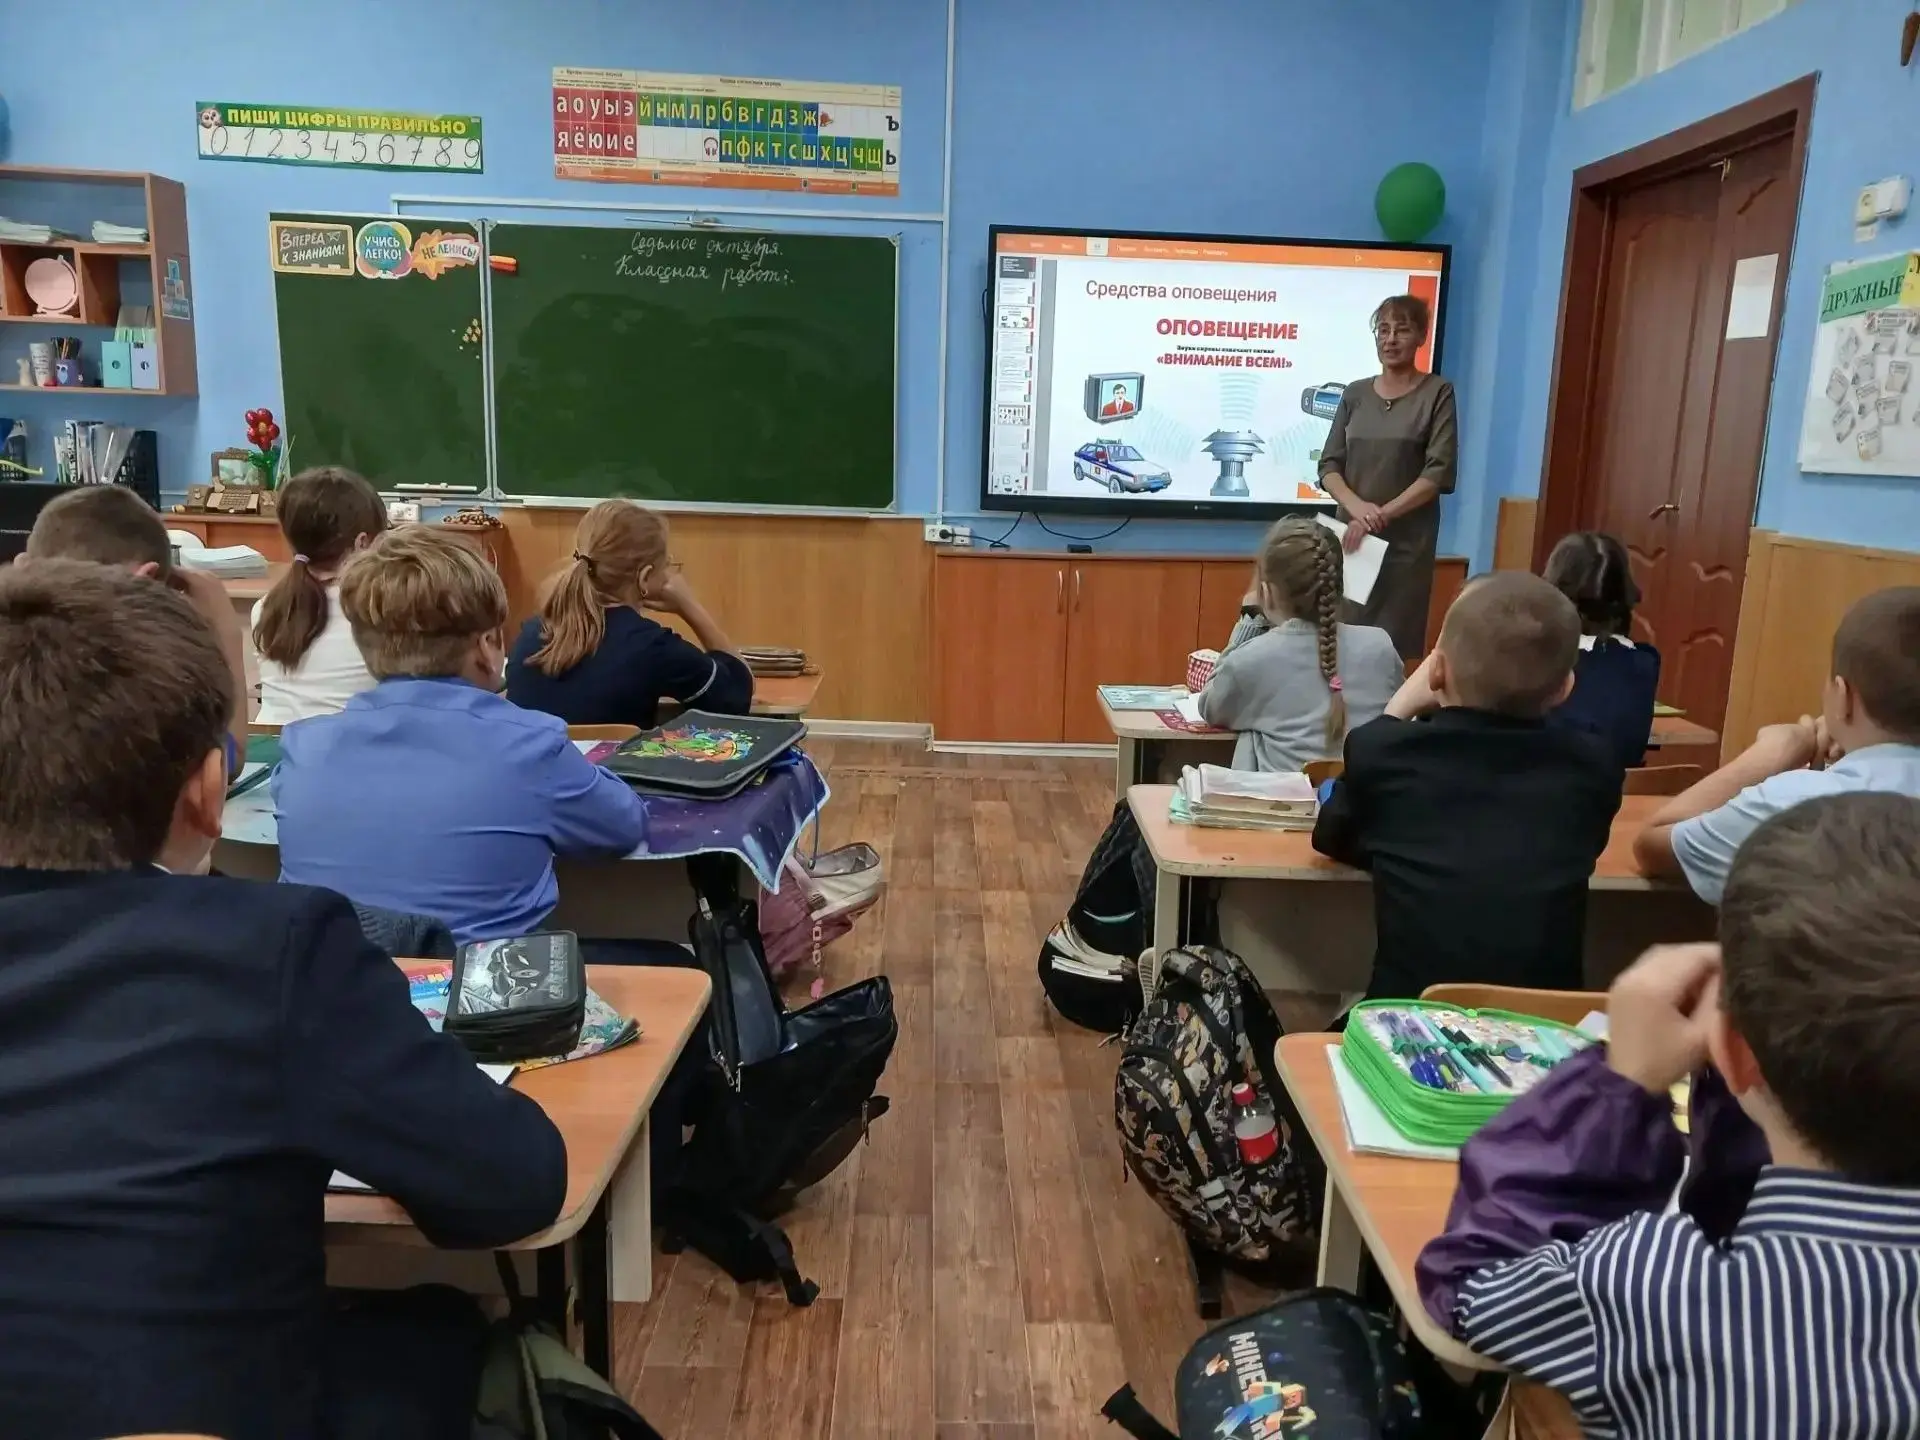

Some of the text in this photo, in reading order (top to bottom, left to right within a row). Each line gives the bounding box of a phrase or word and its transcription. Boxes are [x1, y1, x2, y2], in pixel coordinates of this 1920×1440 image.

[227, 108, 466, 135] ПИШИ ЦИФРЫ ПРАВИЛЬНО
[557, 96, 567, 113] а
[573, 98, 583, 113] о
[590, 98, 600, 120] у
[605, 99, 619, 116] ы
[624, 101, 633, 116] э
[640, 95, 650, 117] й
[657, 101, 667, 118] н
[672, 103, 685, 119] м
[689, 104, 699, 120] л
[706, 105, 716, 126] р
[722, 100, 733, 121] б
[738, 107, 749, 122] в
[756, 107, 764, 123] г
[771, 109, 784, 128] д
[789, 109, 798, 125] з
[803, 110, 817, 126] ж
[210, 126, 480, 168] 0 1 2 3 4 5 6 7 8 9
[557, 131, 569, 148] я
[574, 127, 585, 148] ё
[588, 133, 603, 149] ю
[607, 134, 617, 149] и
[624, 135, 634, 151] е
[722, 140, 732, 156] п
[737, 136, 750, 162] ф
[755, 141, 765, 158] к
[772, 142, 782, 158] т
[789, 144, 797, 160] с
[803, 145, 816, 161] ш
[820, 145, 831, 161] х
[836, 147, 848, 166] ц
[854, 148, 864, 163] ч
[868, 149, 881, 167] щ
[364, 235, 400, 248] УЧИСЬ
[422, 243, 477, 260] НЕ ЛЕНИСЬ!
[631, 232, 697, 257] Седьмое
[282, 244, 346, 264] К ЗНАНИЯМ!
[364, 248, 402, 260] ЛЕГКО!
[614, 254, 709, 279] Классная
[1086, 280, 1277, 303] Средства оповещения
[1823, 274, 1905, 315] ДРУЖНЫЕ
[1156, 318, 1299, 340] ОПОВЕЩЕНИЕ
[1157, 353, 1292, 368] «ВНИМАНИЕ ВСЕМ!»
